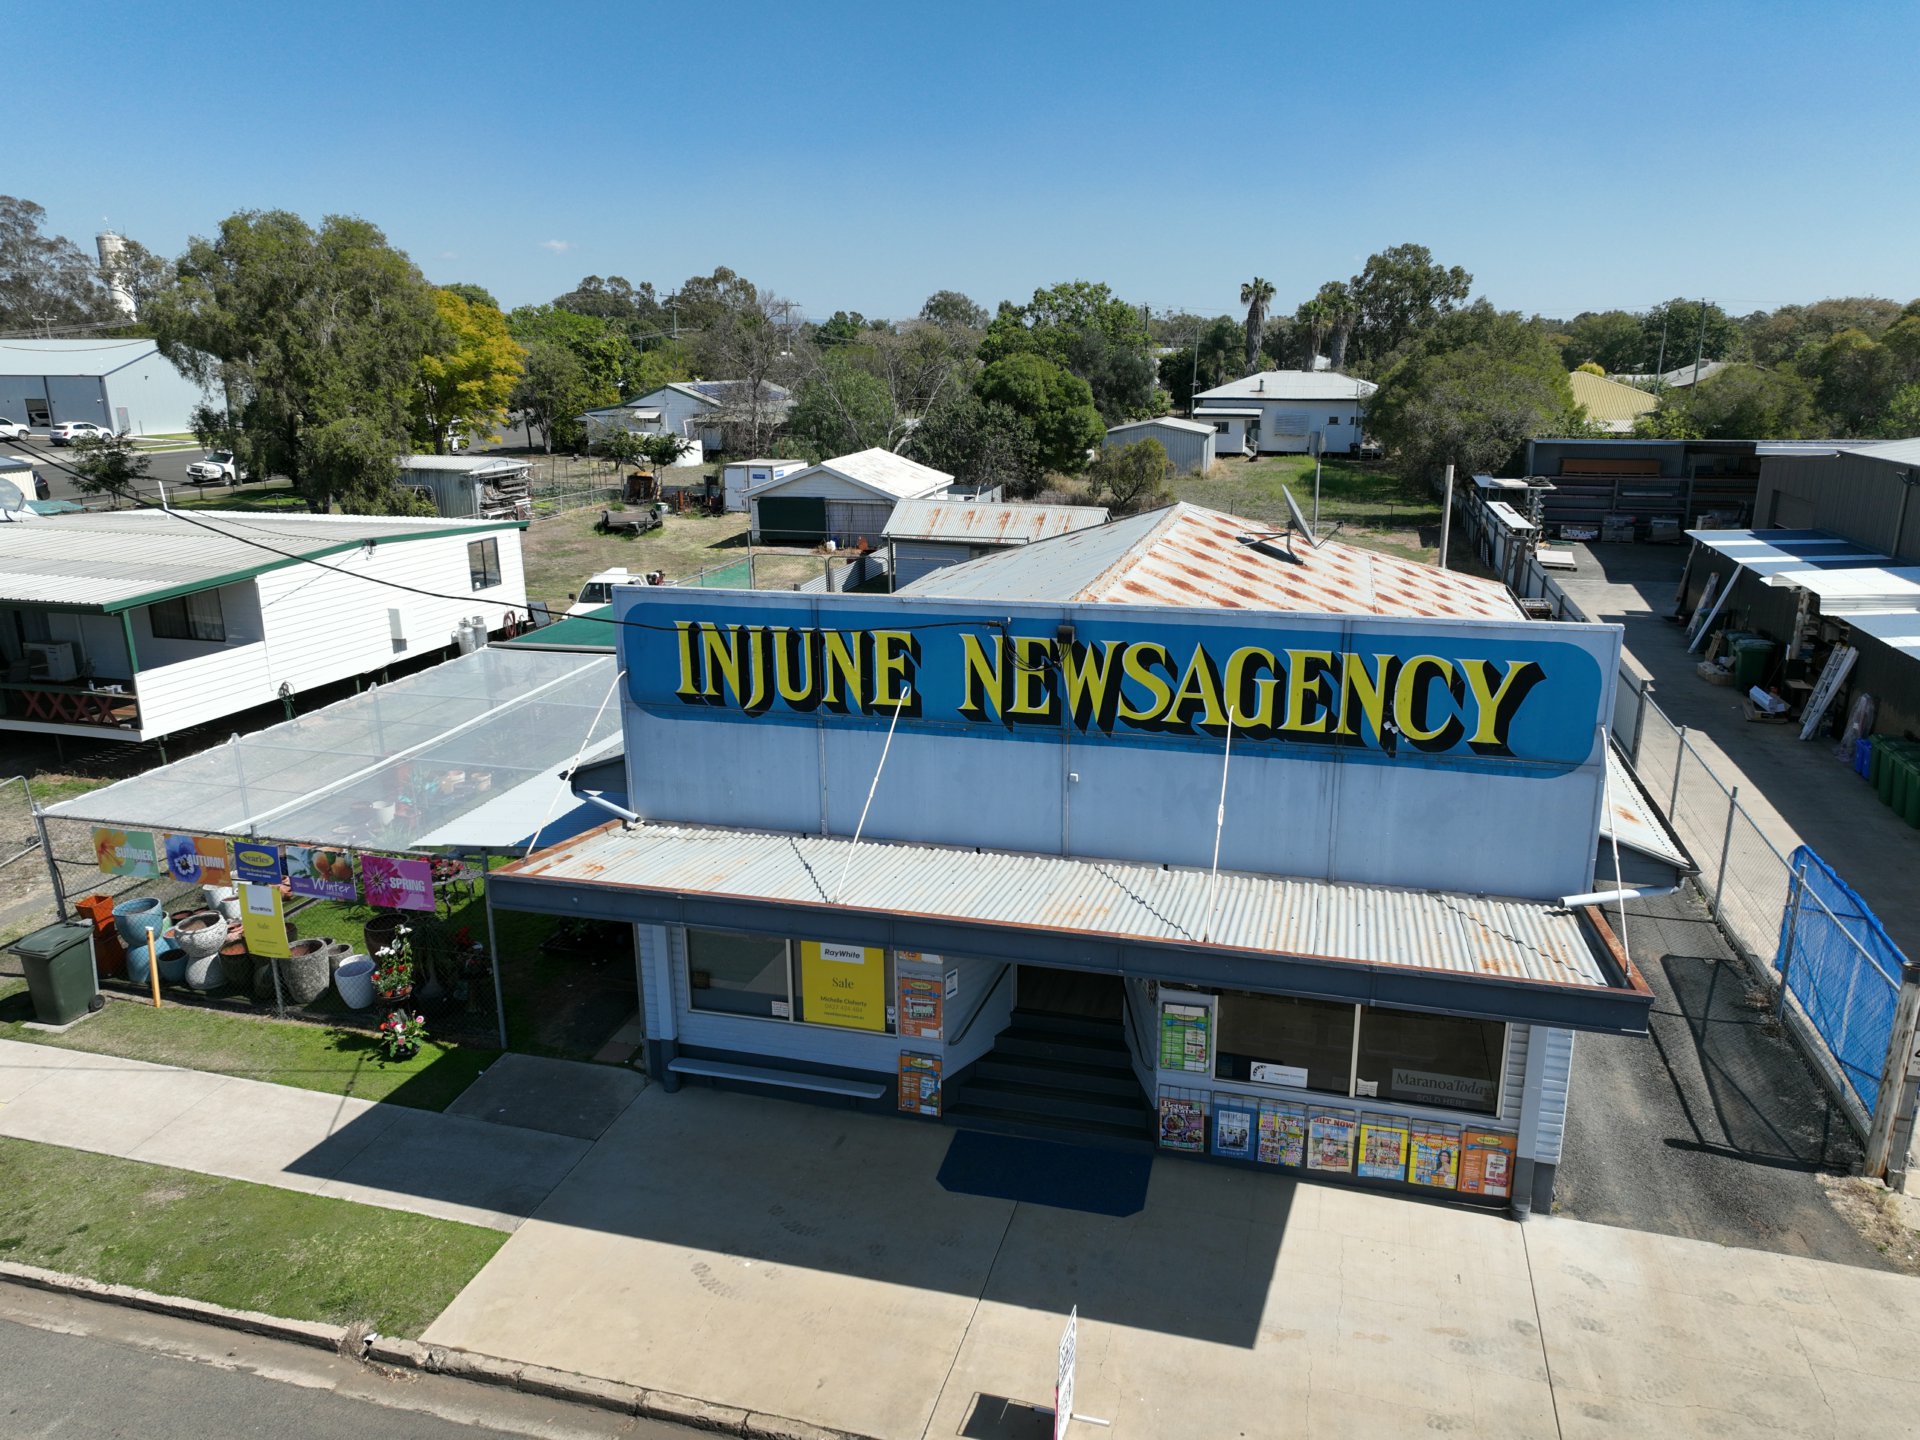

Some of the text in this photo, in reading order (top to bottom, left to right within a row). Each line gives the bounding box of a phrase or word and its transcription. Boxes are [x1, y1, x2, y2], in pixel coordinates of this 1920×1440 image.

[674, 620, 1544, 751] INJUNE NEWSAGENCY
[115, 846, 153, 860] SUMMER
[187, 854, 225, 869] AUTUMN
[311, 877, 351, 892] Winter
[389, 877, 425, 892] SPRING
[824, 948, 860, 959] RayWhite
[832, 977, 854, 989] Sale
[1164, 1100, 1191, 1110] Better
[1333, 1120, 1354, 1129] NOW
